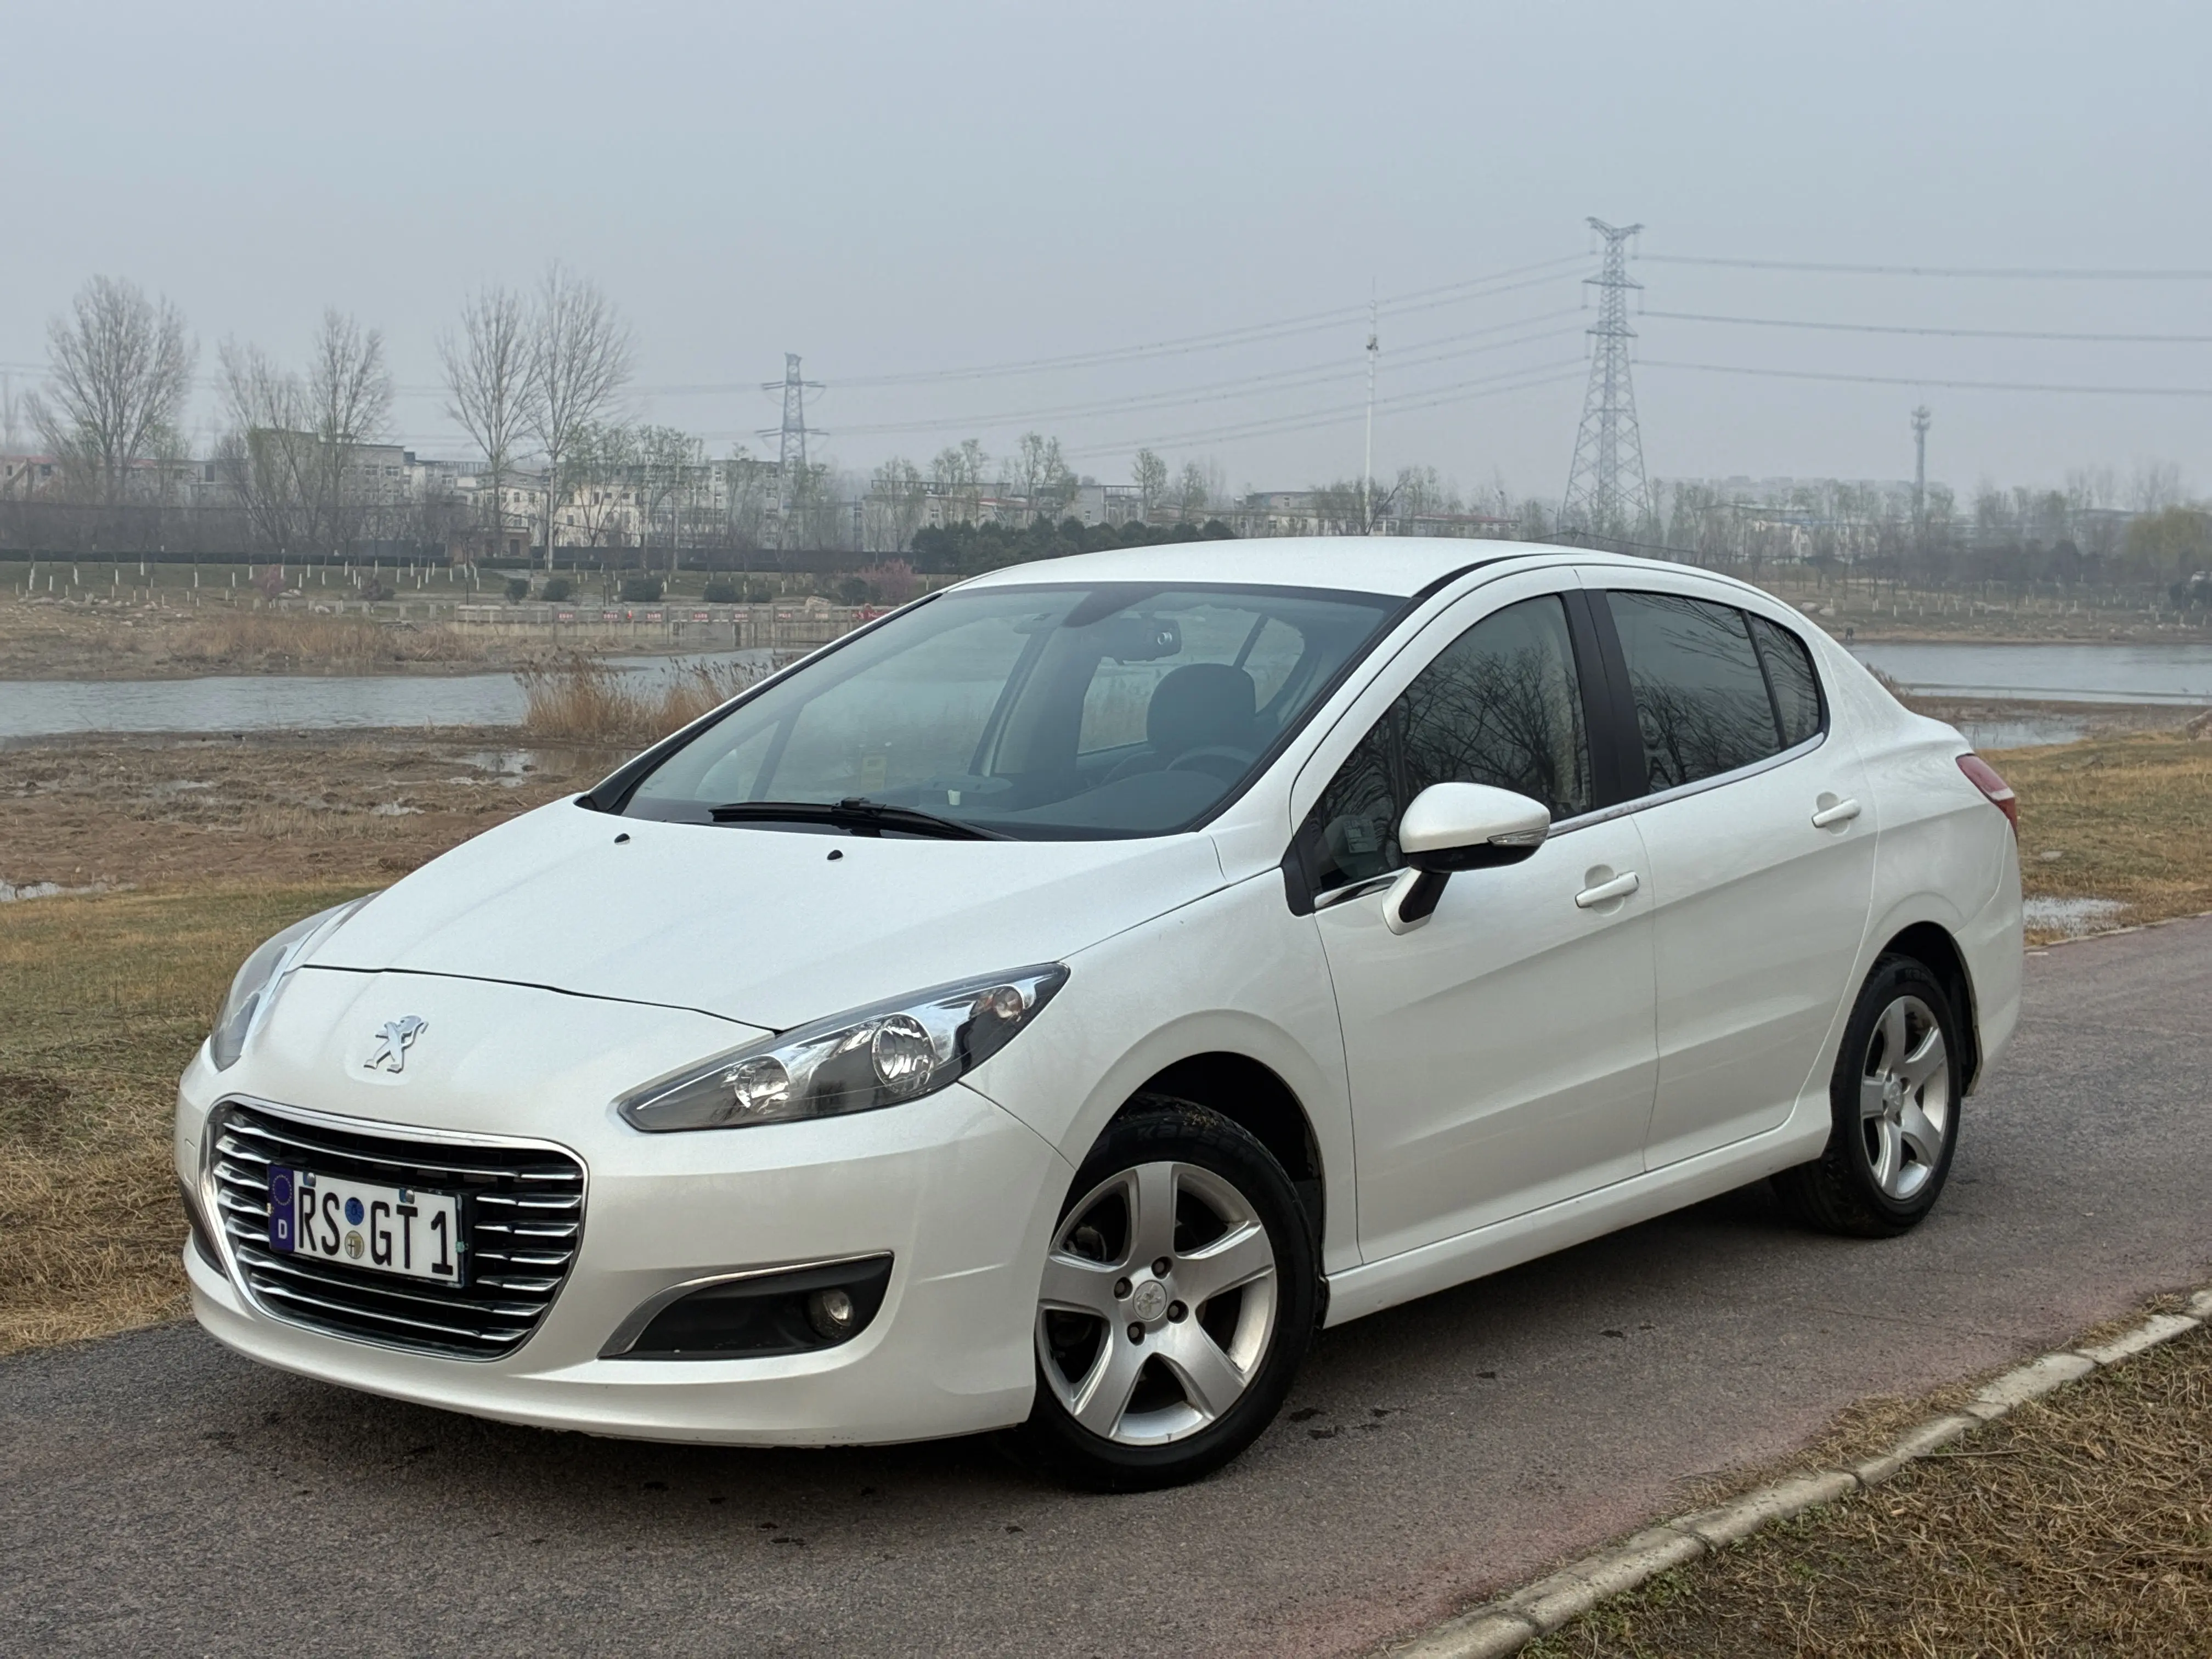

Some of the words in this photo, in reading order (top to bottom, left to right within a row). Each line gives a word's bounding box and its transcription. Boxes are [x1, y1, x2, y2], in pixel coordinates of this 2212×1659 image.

[278, 1218, 288, 1240] D
[298, 1186, 340, 1256] RS
[370, 1200, 418, 1269] GT
[431, 1211, 453, 1276] 1
